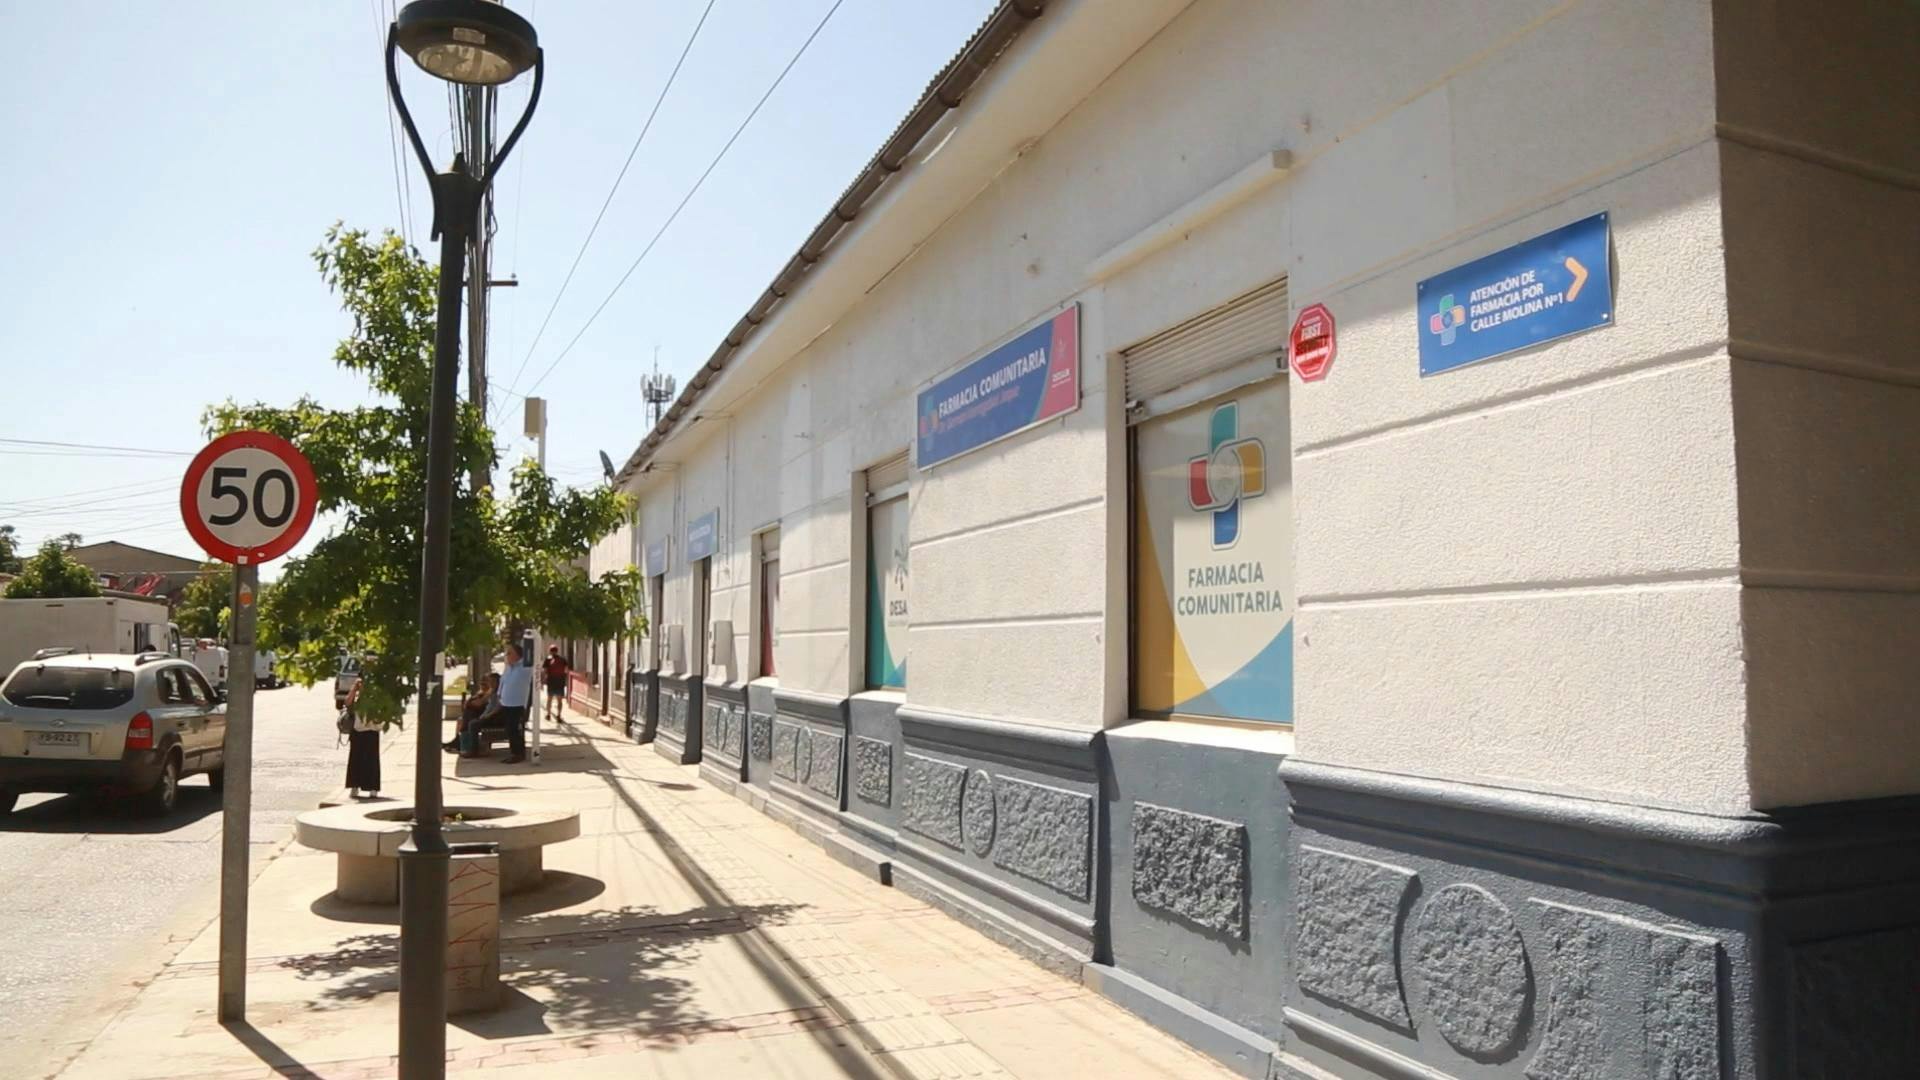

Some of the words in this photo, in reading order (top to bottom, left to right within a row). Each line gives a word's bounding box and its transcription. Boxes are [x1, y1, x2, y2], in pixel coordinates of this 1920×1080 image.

[1470, 276, 1520, 303] ATENCIÓN
[1521, 270, 1536, 286] DE
[1470, 291, 1521, 318] FARMACIA
[1522, 283, 1545, 301] POR
[1470, 312, 1502, 332] CALLE
[1502, 298, 1543, 323] MOLINA
[939, 383, 979, 418] FARMACIA
[979, 347, 1046, 397] COMUNITARIA
[208, 467, 295, 528] 50
[1188, 561, 1264, 589] FARMACIA
[1177, 590, 1283, 616] COMUNITARIA
